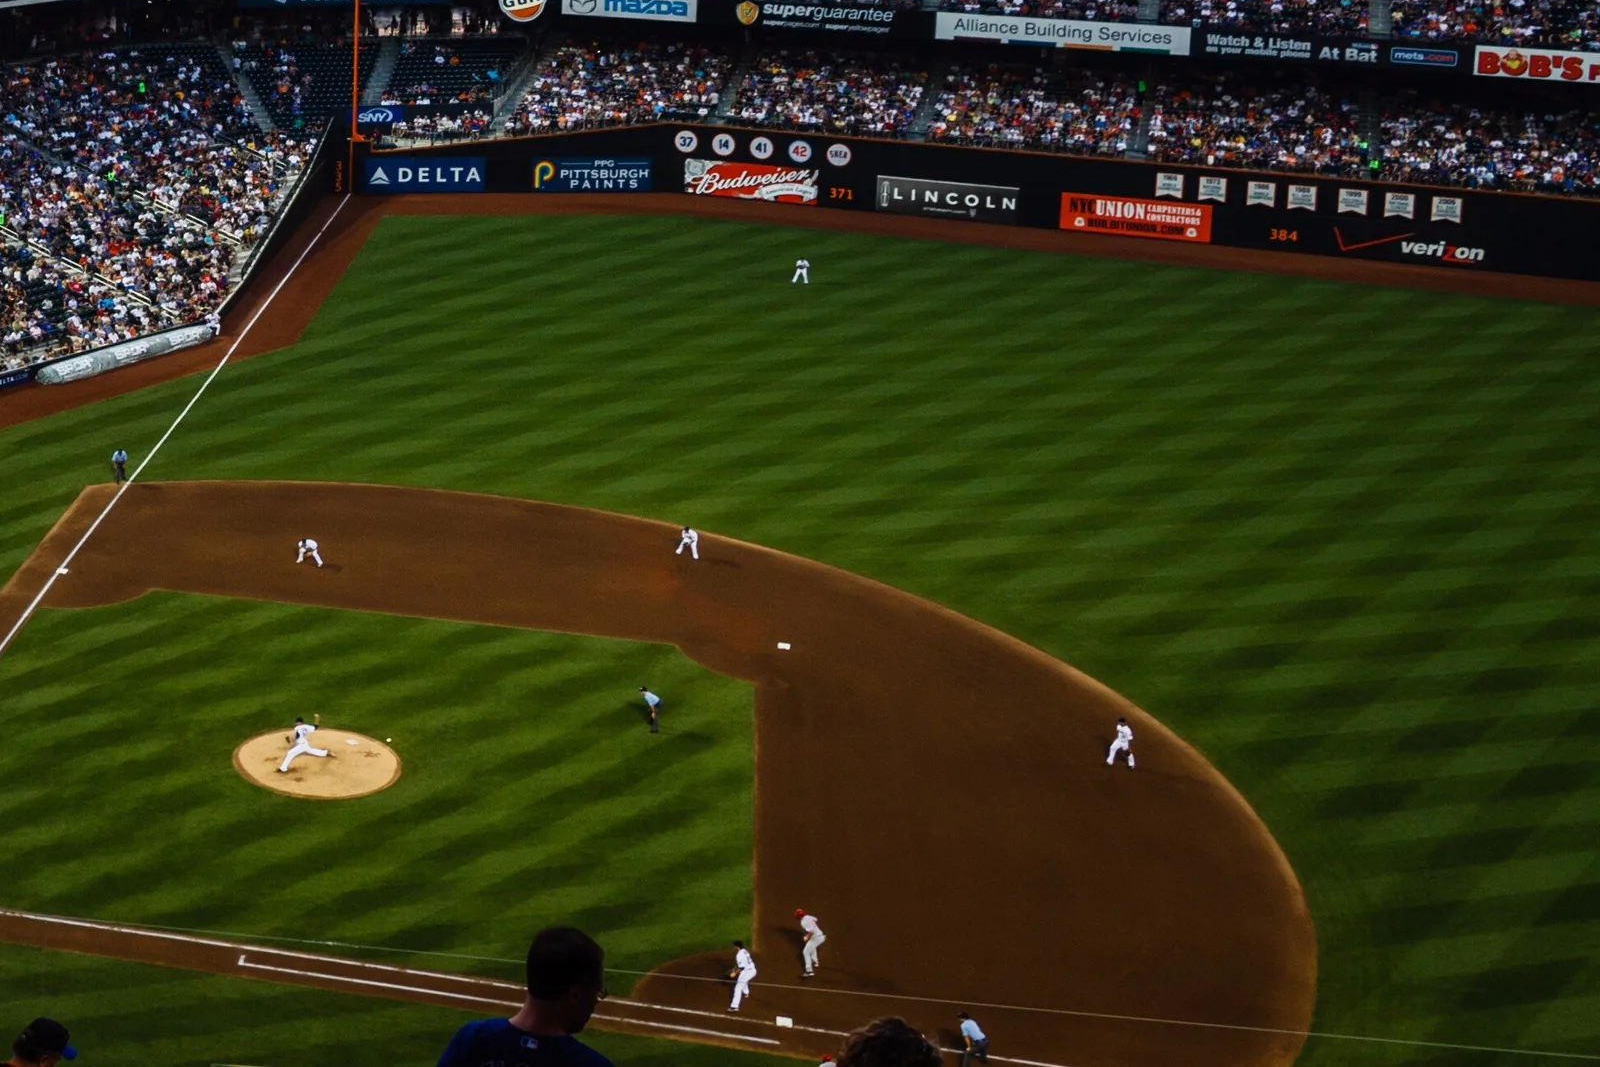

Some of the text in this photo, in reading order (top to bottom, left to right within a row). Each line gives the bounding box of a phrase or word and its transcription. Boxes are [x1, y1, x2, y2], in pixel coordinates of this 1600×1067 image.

[763, 3, 894, 22] superguarantee
[954, 18, 1172, 44] Alliance Building Services
[1207, 34, 1311, 51] Watch & Listen
[1220, 47, 1242, 55] your
[1245, 48, 1278, 56] mobile
[1280, 50, 1311, 58] phone
[1318, 47, 1378, 63] At Bat
[1394, 51, 1454, 63] mets.com
[1478, 50, 1584, 81] BOB'S
[358, 112, 387, 123] SNY
[680, 136, 693, 147] 37
[719, 139, 729, 149] 14
[755, 142, 767, 153] 41
[792, 146, 807, 157] 42
[830, 150, 848, 159] SHEA
[398, 167, 481, 182] DELTA
[560, 169, 649, 179] PITTSBURGH
[570, 180, 638, 188] PAINTS
[691, 167, 810, 194] Budweiser
[830, 188, 853, 200] 371
[893, 187, 1016, 210] LINCOLN
[1146, 214, 1201, 225] CONTRACTORS
[1270, 229, 1297, 241] 384
[1401, 241, 1485, 262] verizon
